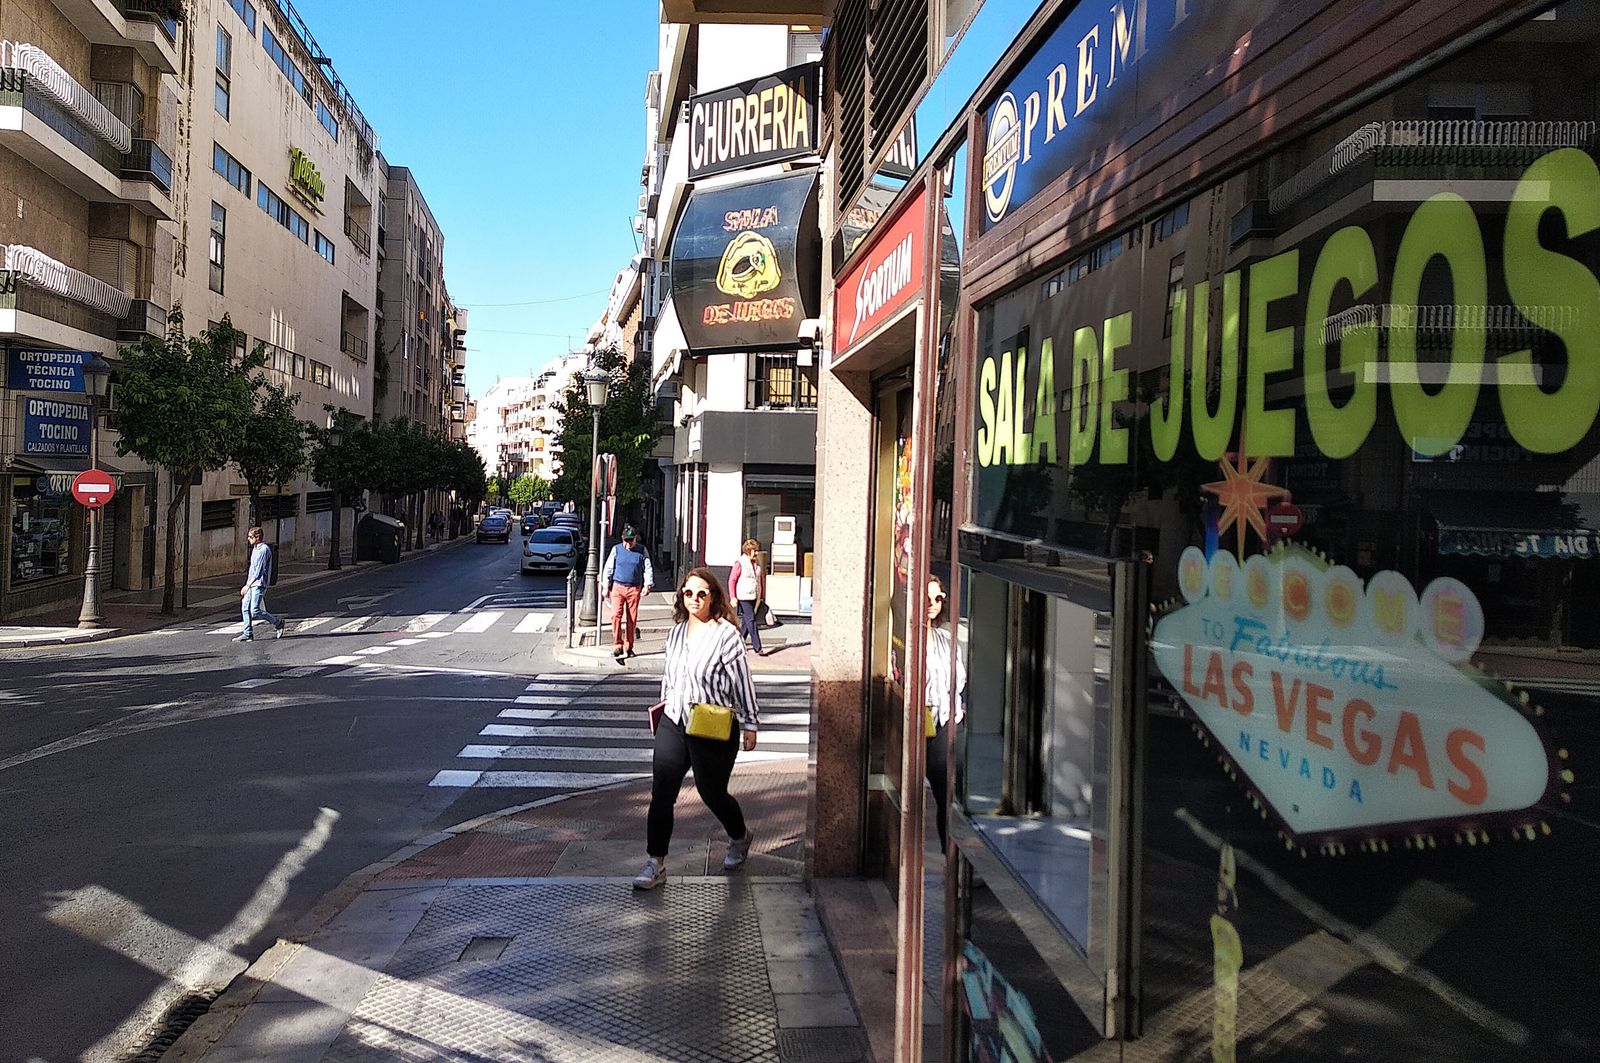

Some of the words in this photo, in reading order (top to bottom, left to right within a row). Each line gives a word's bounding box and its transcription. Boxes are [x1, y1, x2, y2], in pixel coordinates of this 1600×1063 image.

[691, 75, 809, 170] CHURRERIA
[849, 231, 913, 345] SPORTIUM
[976, 336, 1057, 468] SALA
[1068, 311, 1135, 465] DE
[1149, 147, 1600, 462] JUEGOS
[19, 351, 83, 364] ORTOPEDIA
[26, 363, 75, 377] TÉCNICA
[29, 378, 71, 390] TOCINO
[29, 400, 88, 421] ORTOPEDIA
[39, 423, 78, 440] TOCINO
[27, 442, 56, 453] CALZADOS
[60, 443, 88, 453] PLANTILLAS
[1201, 618, 1225, 641] TO
[1230, 616, 1399, 690] Fabulous
[1183, 644, 1254, 717] LAS
[1271, 671, 1489, 806] VEGAS
[1239, 731, 1364, 803] NEVADA
